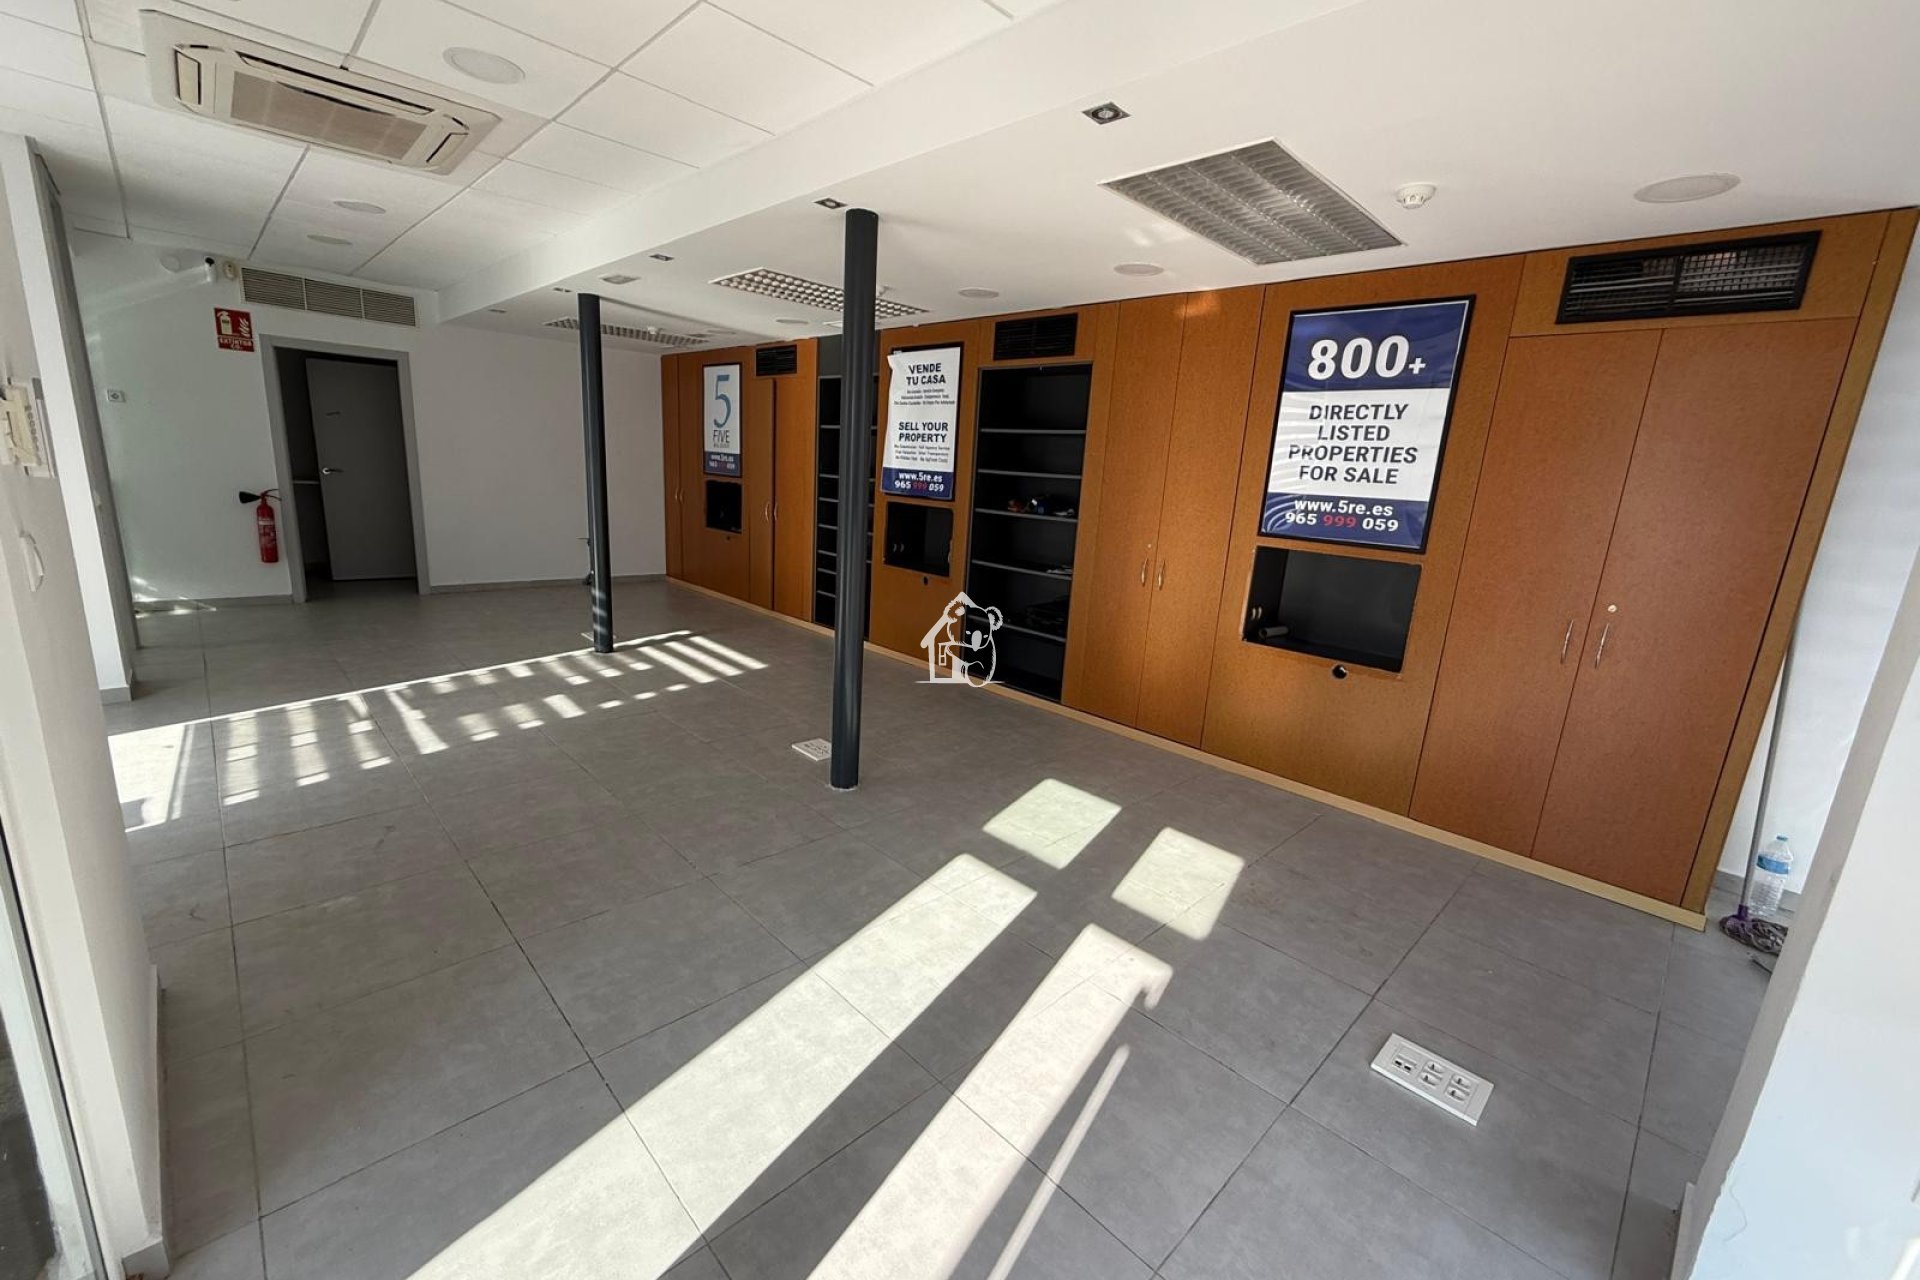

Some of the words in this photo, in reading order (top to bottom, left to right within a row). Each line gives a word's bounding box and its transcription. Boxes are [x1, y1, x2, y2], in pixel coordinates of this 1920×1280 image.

[1307, 335, 1426, 380] 800+
[908, 363, 942, 374] VENDE
[906, 376, 919, 386] TU
[921, 374, 946, 385] CASA
[714, 375, 731, 428] 5
[1309, 403, 1409, 420] DIRECTLY
[898, 421, 920, 431] SELL
[922, 422, 949, 432] YOUR
[1317, 425, 1391, 441] LISTED
[713, 430, 730, 444] FIVE
[898, 432, 947, 443] PROPERTY
[1288, 445, 1418, 464] PROPERTIES
[898, 471, 943, 483] www.5re.es
[1299, 465, 1337, 482] FOR
[1344, 467, 1399, 484] SALE
[894, 480, 911, 489] 965
[928, 482, 944, 492] 059
[1294, 499, 1394, 516] www.5re.es
[1285, 512, 1318, 526] 965
[1323, 515, 1357, 528] 999
[1362, 517, 1399, 532] 059
